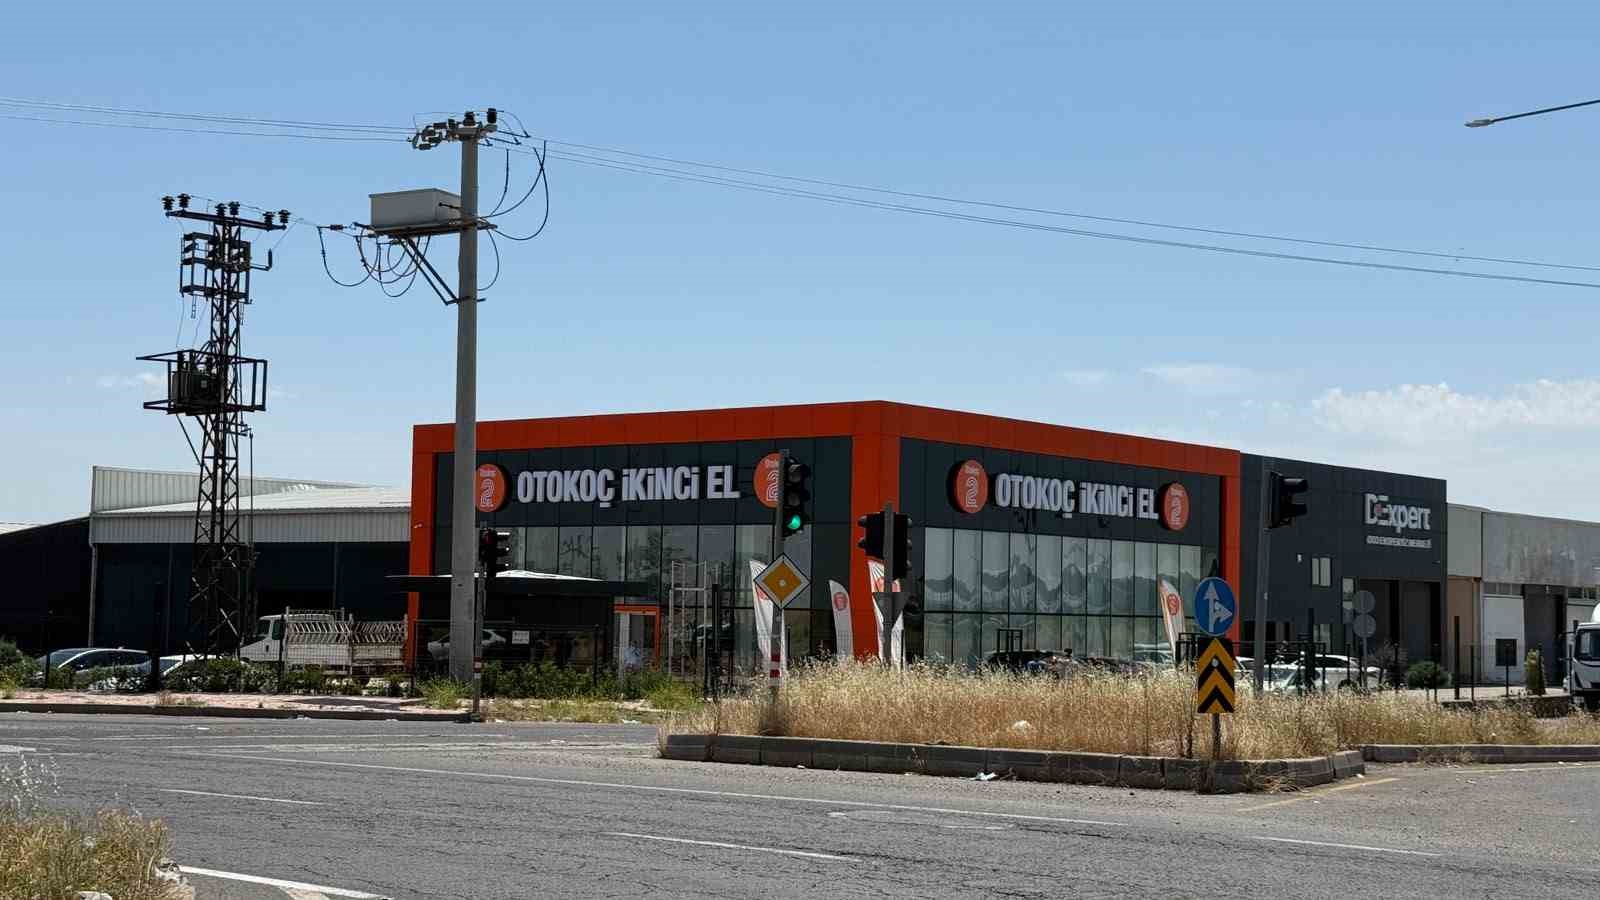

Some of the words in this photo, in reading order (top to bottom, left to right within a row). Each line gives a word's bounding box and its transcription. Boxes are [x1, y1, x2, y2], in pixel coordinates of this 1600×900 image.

[517, 468, 615, 508] OTOKOÇ
[706, 465, 741, 499] EL
[995, 473, 1075, 519] OTOKOÇ
[1136, 488, 1159, 520] EL
